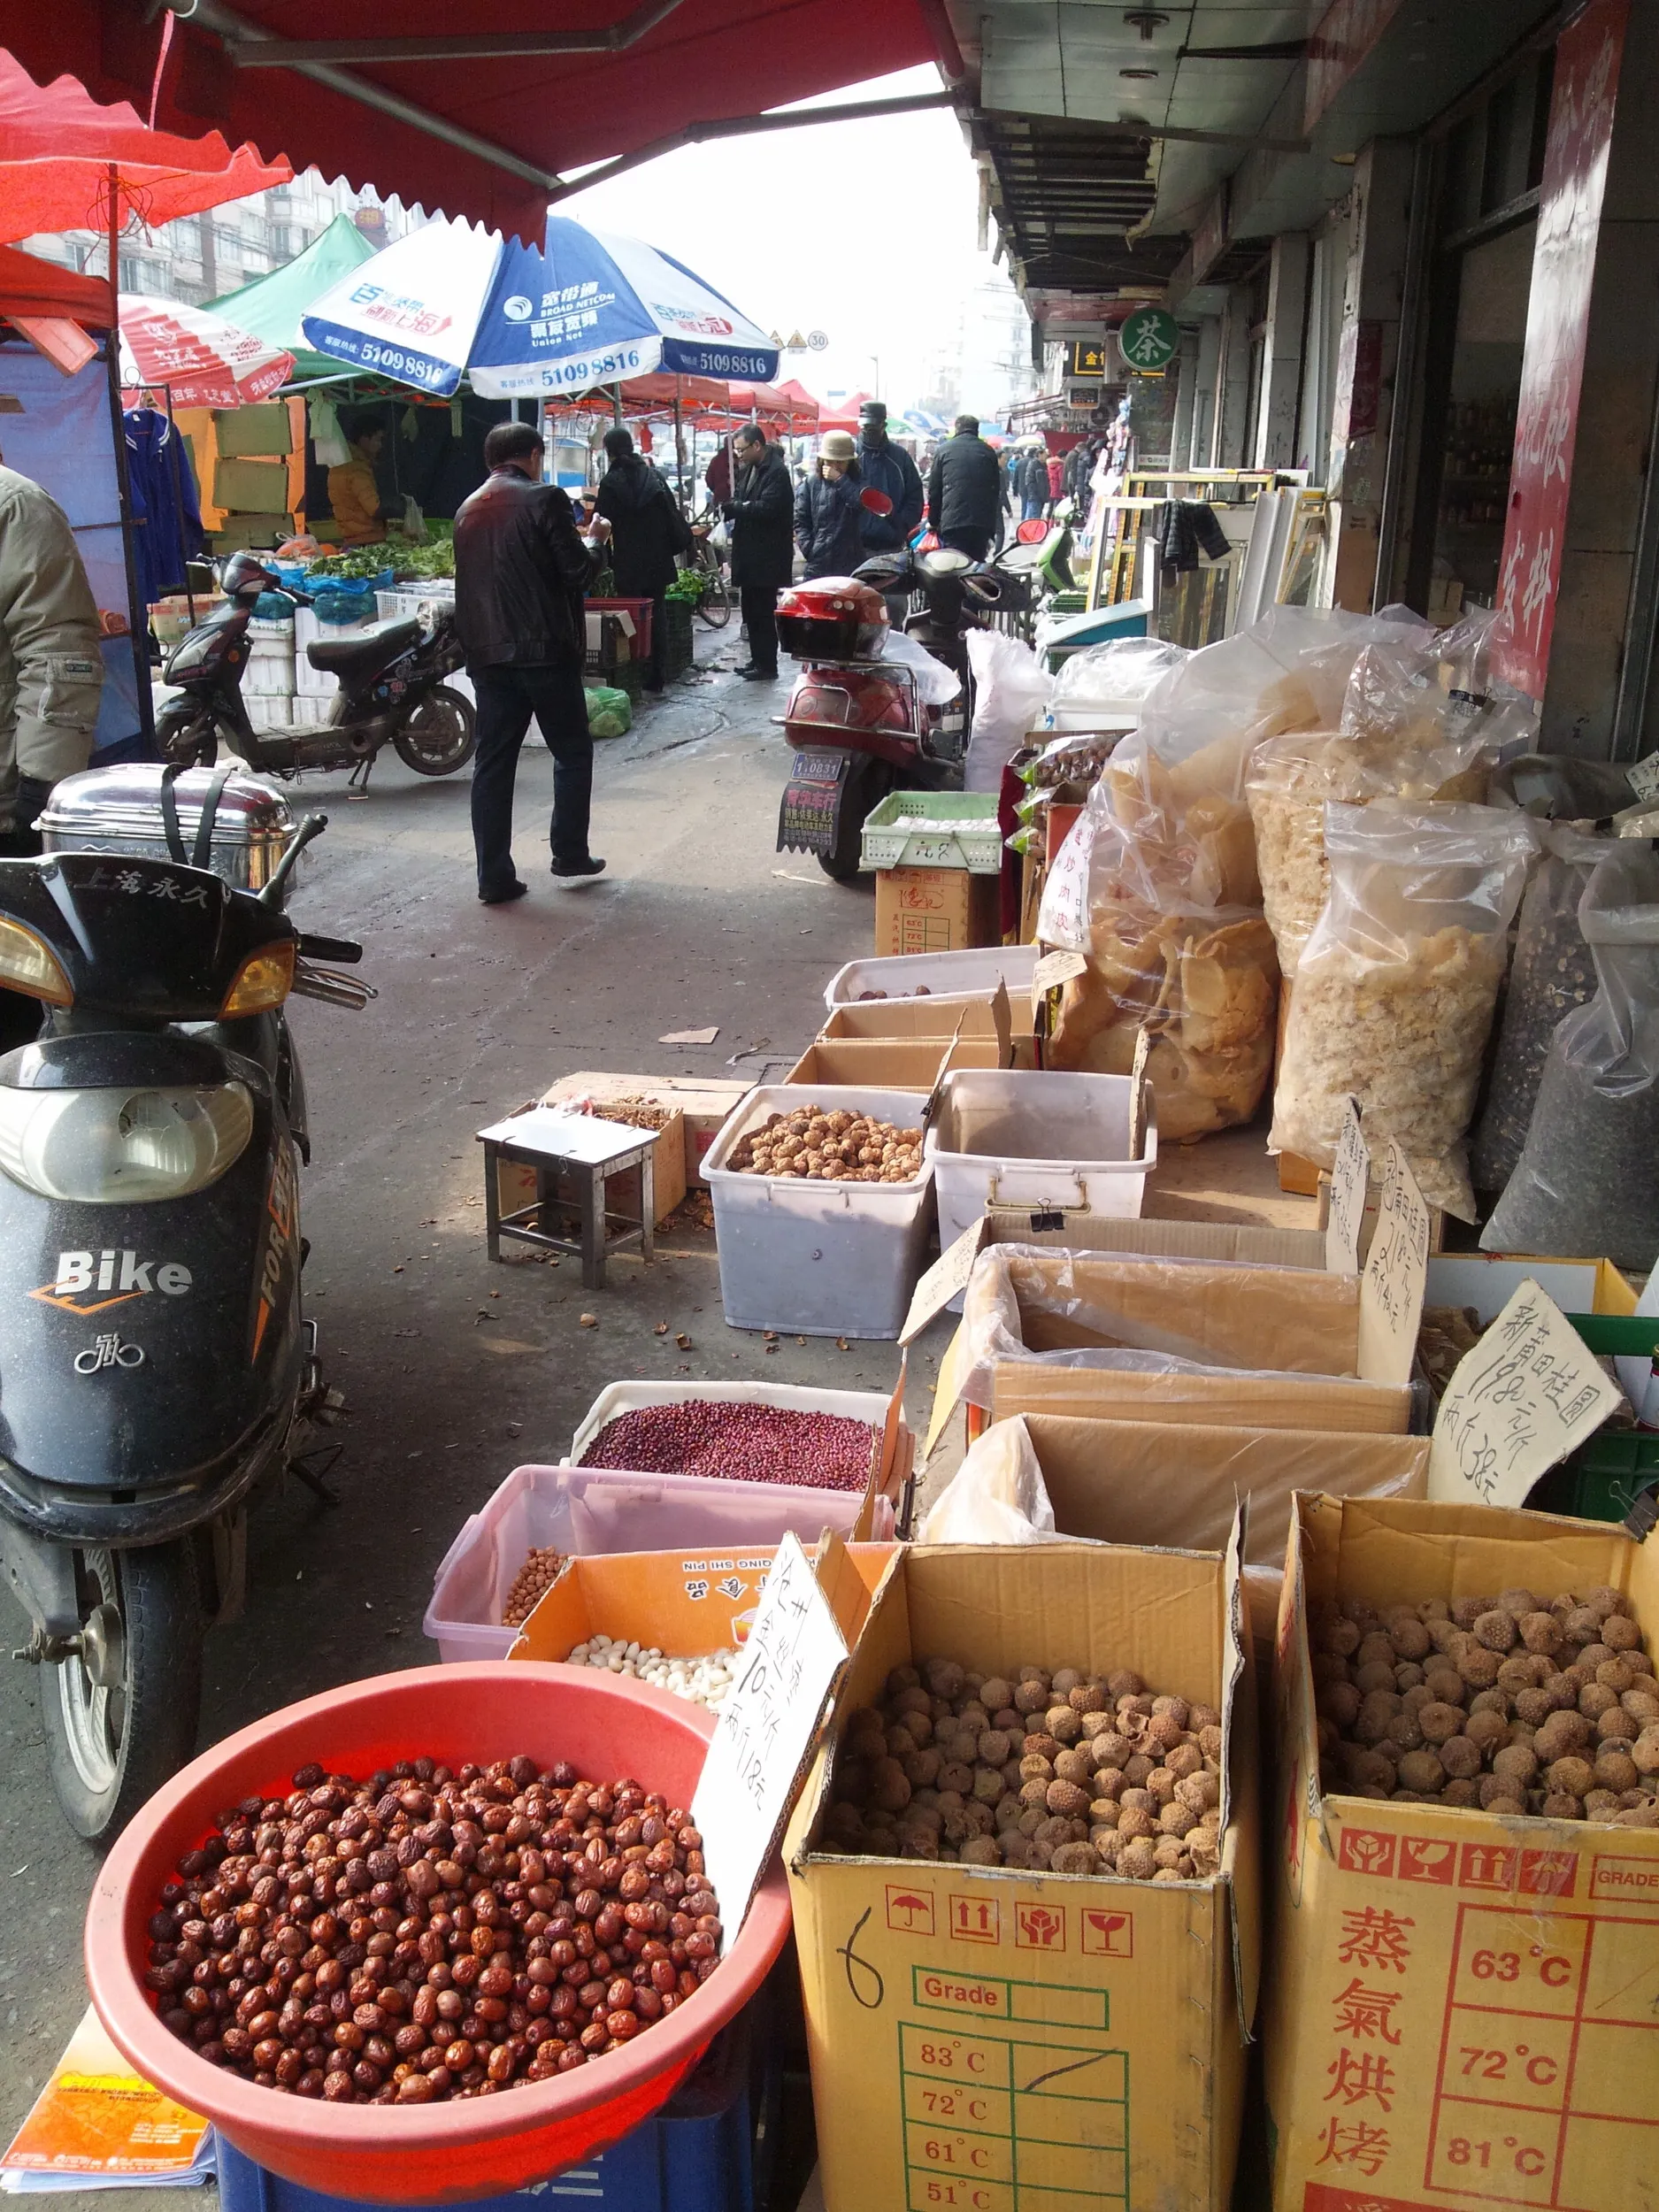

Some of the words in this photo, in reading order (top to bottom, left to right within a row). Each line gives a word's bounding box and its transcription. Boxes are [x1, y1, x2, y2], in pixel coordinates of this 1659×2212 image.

[541, 303, 573, 318] BROAD
[576, 293, 616, 309] NETCOM
[532, 335, 562, 348] Union
[565, 332, 583, 342] Net
[1128, 315, 1171, 362] 茶
[55, 1249, 193, 1296] Bike
[684, 1563, 705, 1571] PIN
[711, 1561, 733, 1570] SHI
[687, 1576, 766, 1599] 食品
[1598, 1870, 1659, 1887] GRADE
[924, 1976, 999, 2007] Grade
[1315, 1905, 1416, 2177] 蒸氣烘烤
